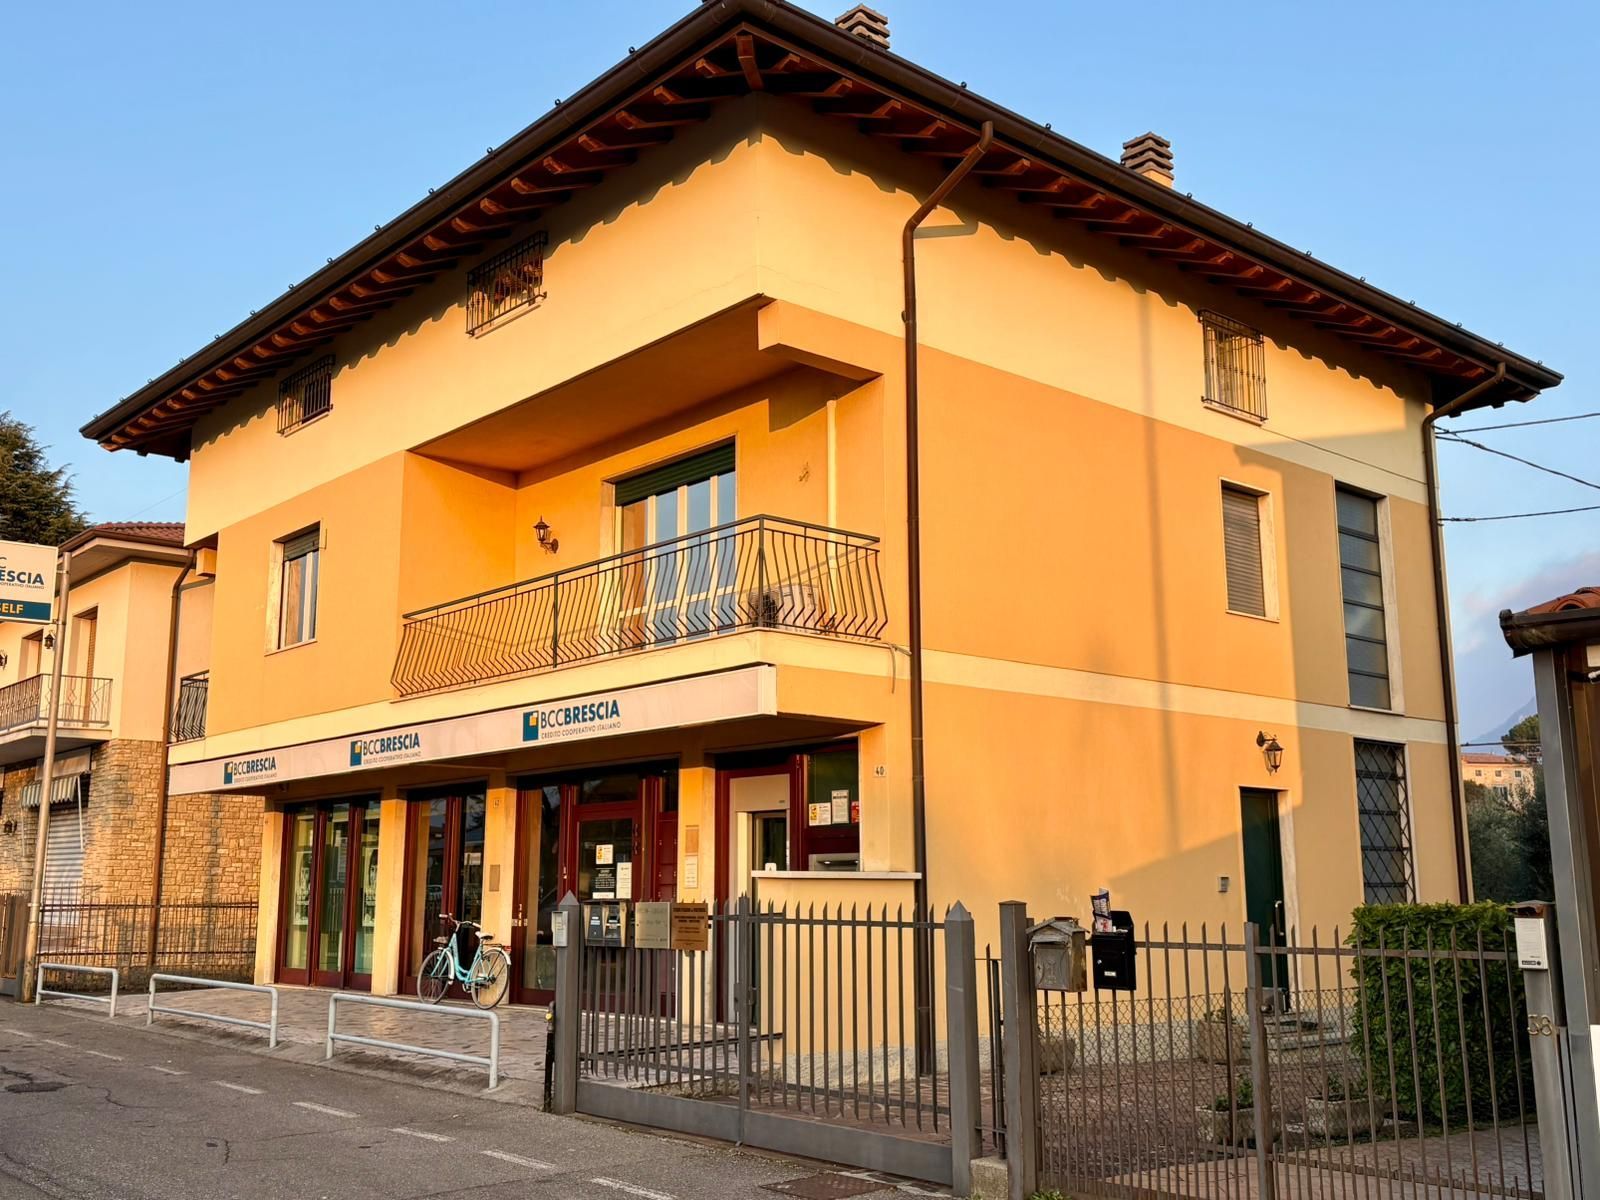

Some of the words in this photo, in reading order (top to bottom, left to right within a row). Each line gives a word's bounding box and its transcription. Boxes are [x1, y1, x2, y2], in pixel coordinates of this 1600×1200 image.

[0, 602, 24, 614] ELF
[541, 700, 620, 729] BCCBRESCIA
[562, 725, 596, 737] COOPERATIVO
[597, 721, 621, 732] ITALIANO
[363, 732, 420, 756] BCCBRESCIA
[233, 756, 276, 776] BCCBRESCIA
[875, 766, 885, 776] 40
